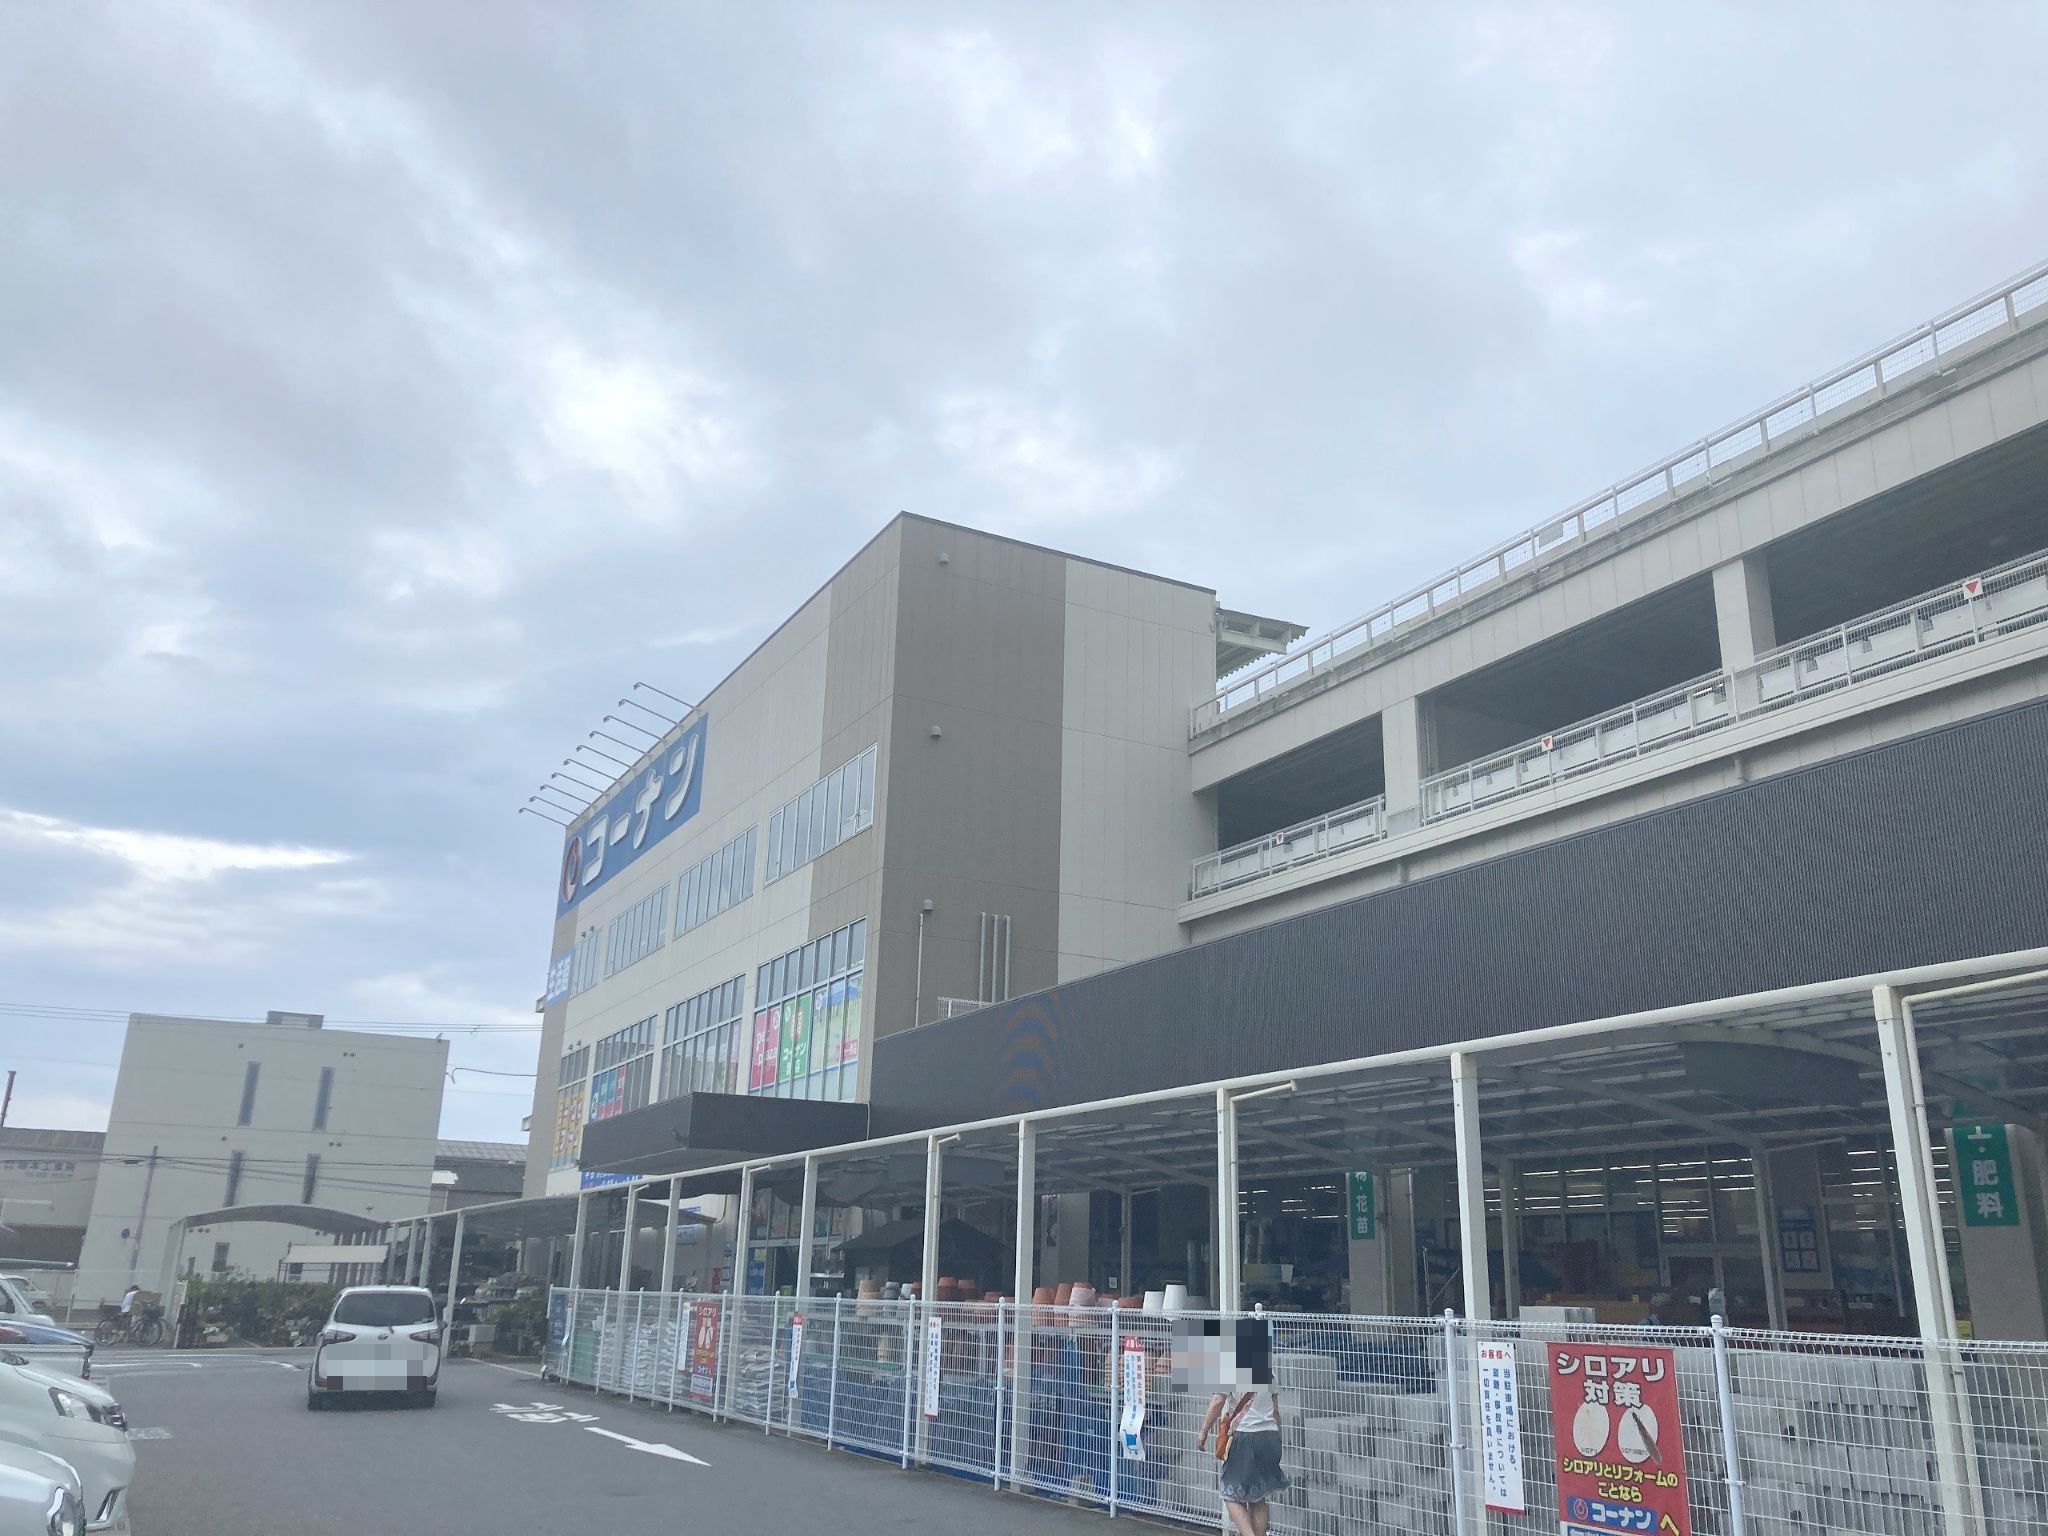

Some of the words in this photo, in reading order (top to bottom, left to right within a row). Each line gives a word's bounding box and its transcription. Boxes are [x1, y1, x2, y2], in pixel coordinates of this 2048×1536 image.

[582, 733, 700, 887] コーナン
[1480, 1349, 1512, 1360] お客様へ
[1556, 1351, 1666, 1383] シロアリ
[1583, 1380, 1643, 1408] 対策
[1563, 1457, 1679, 1488] シロアリとリフォームの
[1597, 1481, 1643, 1504] ことなら
[1591, 1502, 1652, 1531] コーナン
